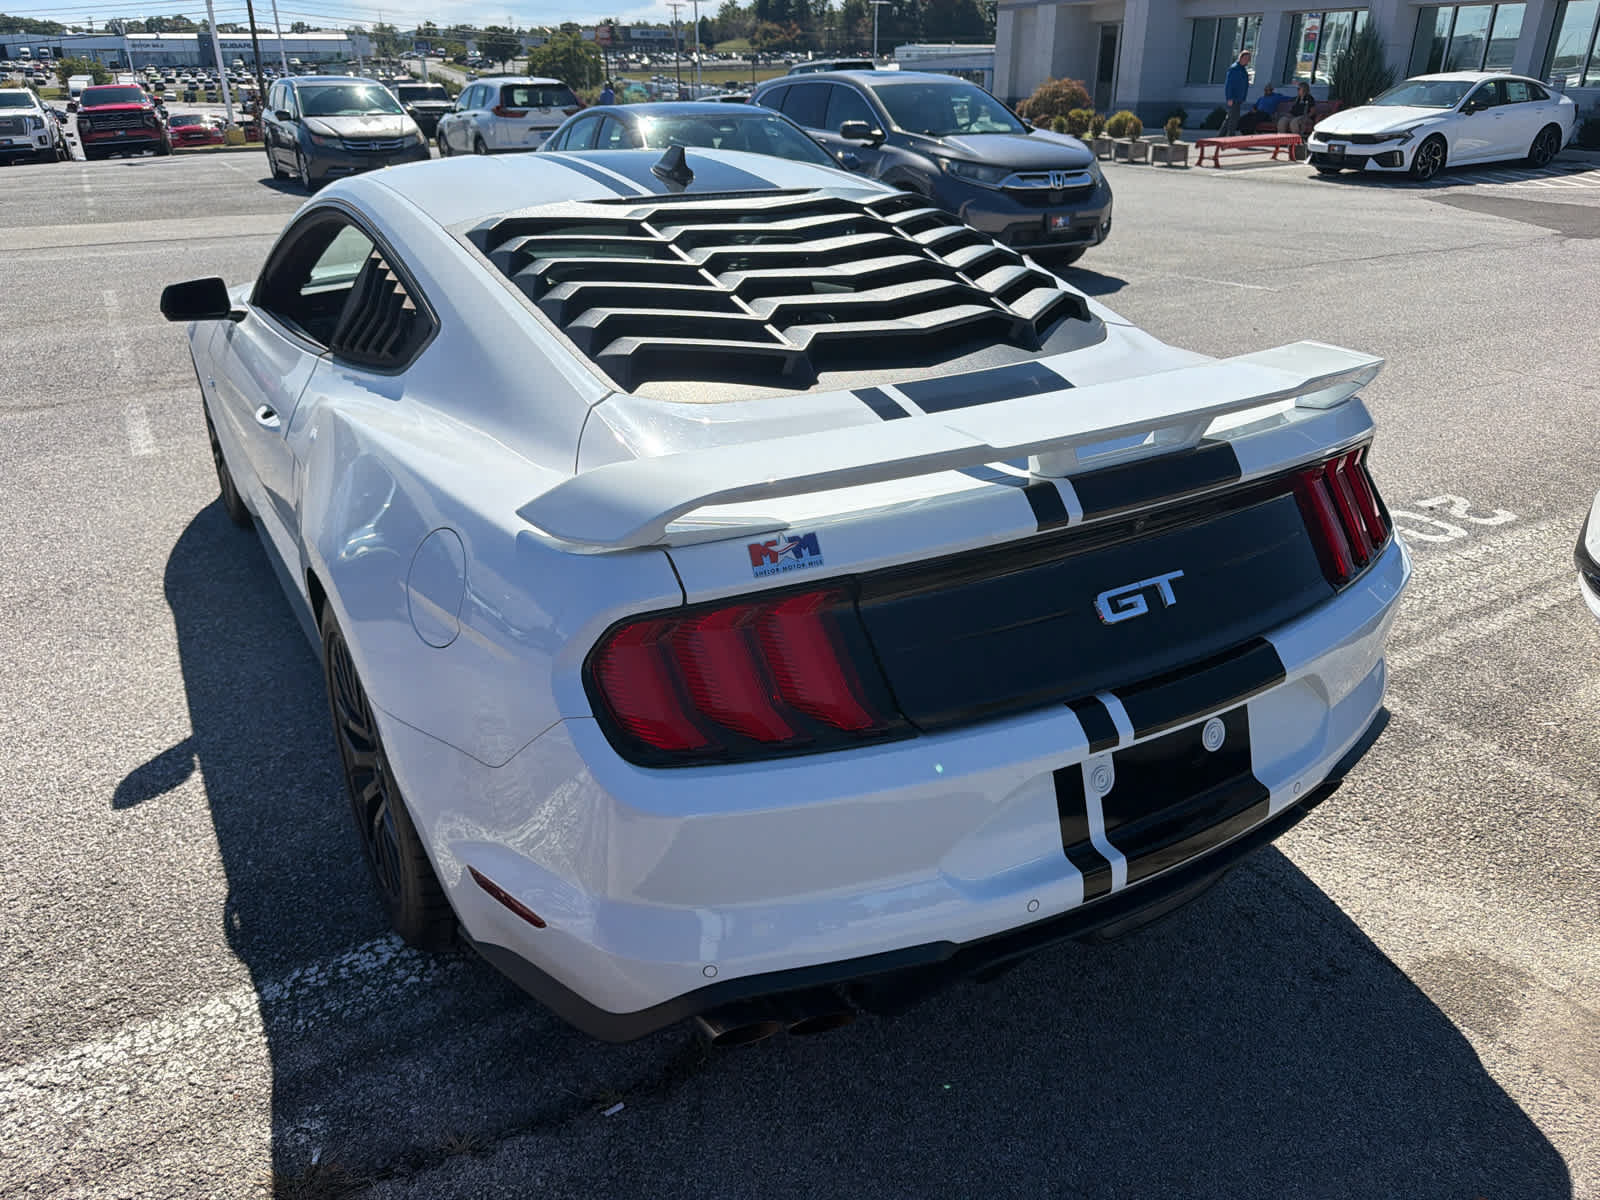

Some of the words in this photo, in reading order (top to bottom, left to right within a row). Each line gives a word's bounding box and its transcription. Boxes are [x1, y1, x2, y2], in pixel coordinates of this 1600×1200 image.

[783, 562, 805, 572] MOTOR
[808, 559, 823, 568] MILE
[1093, 569, 1184, 625] GT
